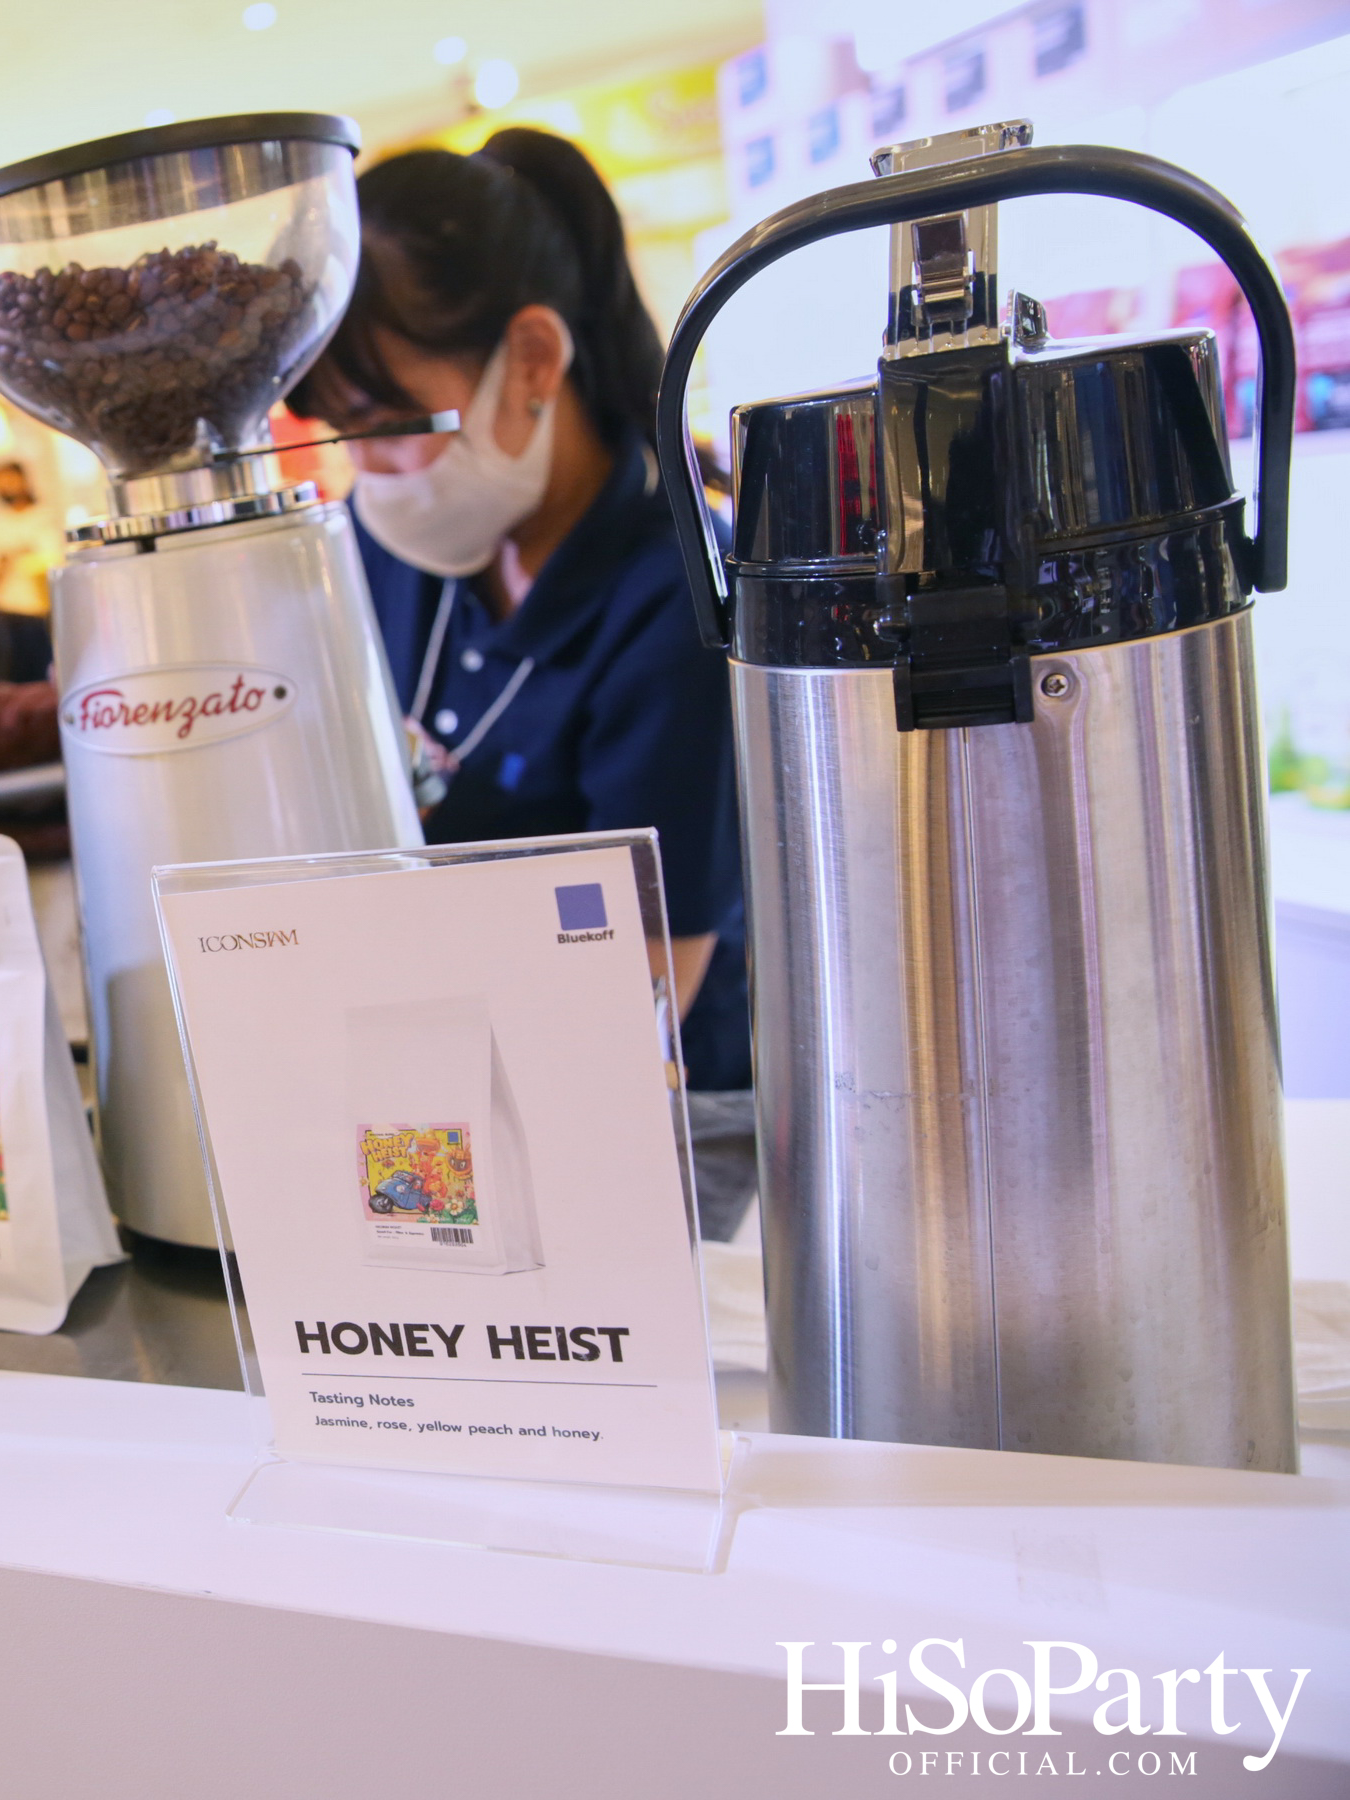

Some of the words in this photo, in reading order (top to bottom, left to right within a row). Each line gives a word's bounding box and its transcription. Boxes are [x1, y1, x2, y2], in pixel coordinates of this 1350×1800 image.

[80, 673, 266, 740] Fiorenzato
[198, 929, 299, 953] ICONSIAM
[557, 929, 615, 944] Bluekoff
[359, 1133, 414, 1156] HONEY
[294, 1320, 466, 1359] HONEY
[486, 1325, 630, 1363] HEIST
[308, 1391, 365, 1408] Tasting
[368, 1394, 416, 1408] Notes
[314, 1416, 373, 1430] Jasmine,
[377, 1420, 412, 1432] rose,
[417, 1421, 463, 1433] yellow
[468, 1424, 514, 1436] peach
[518, 1426, 547, 1437] and
[551, 1426, 604, 1442] honey.
